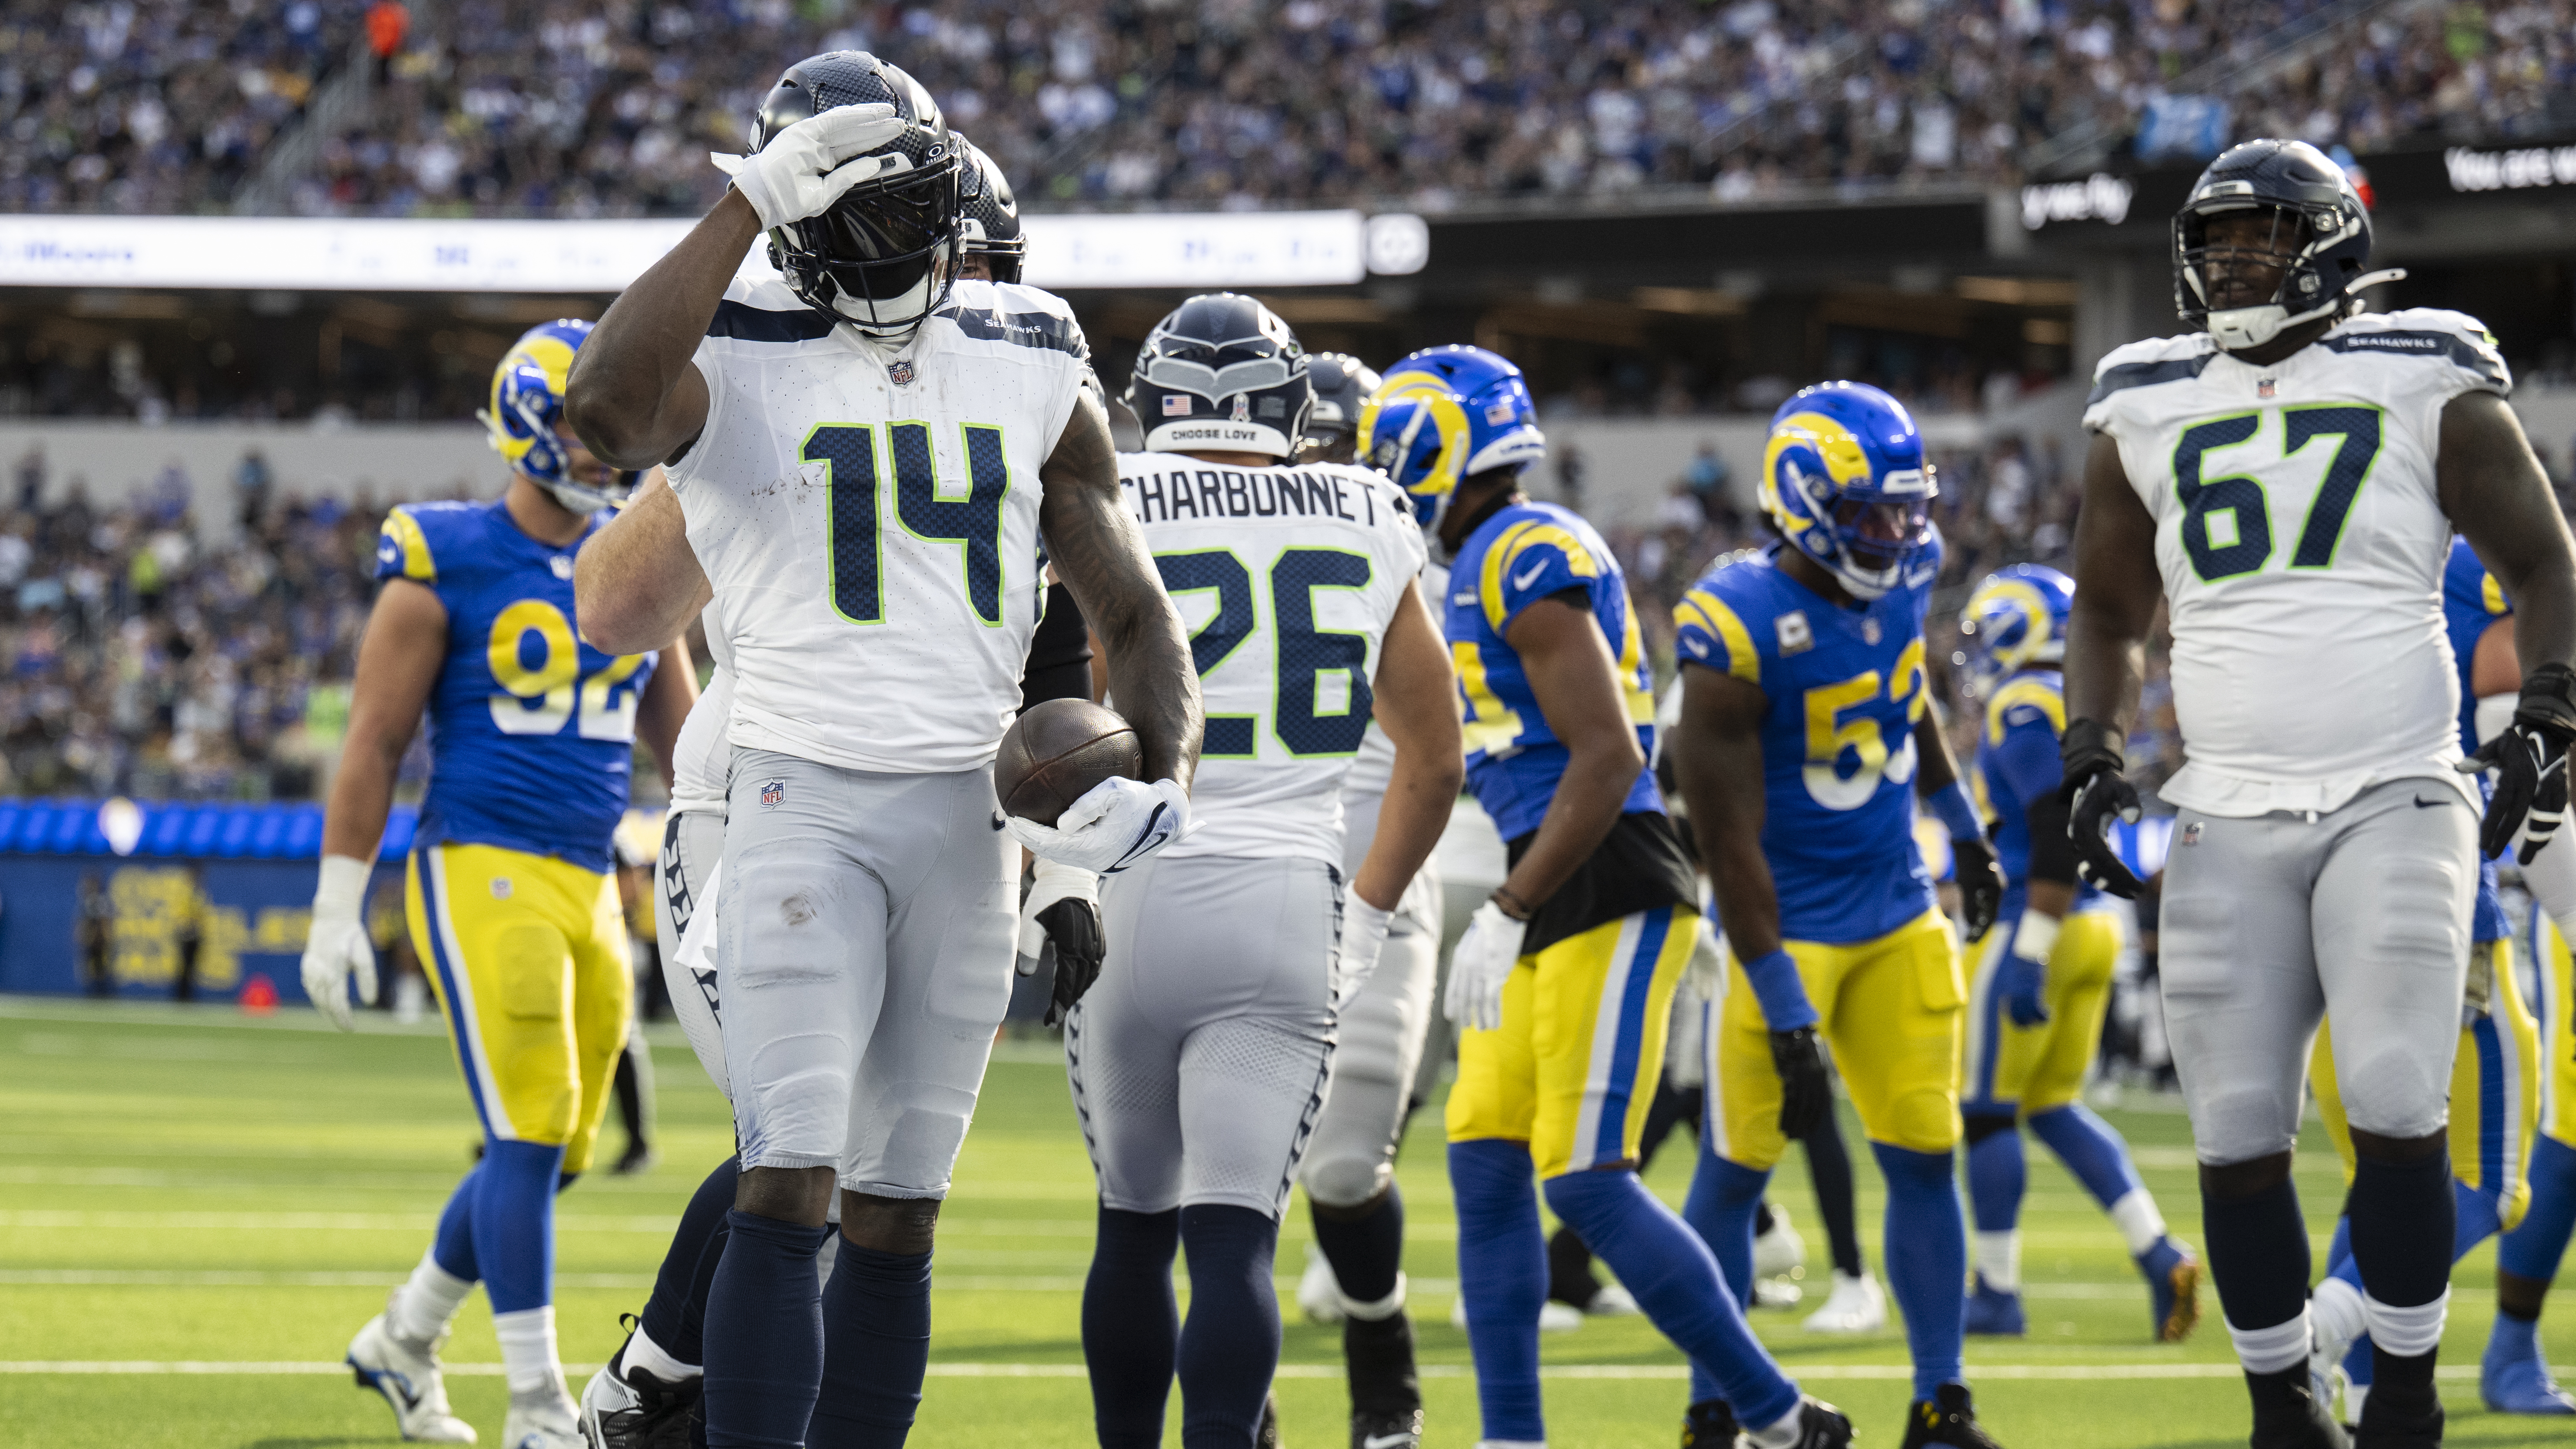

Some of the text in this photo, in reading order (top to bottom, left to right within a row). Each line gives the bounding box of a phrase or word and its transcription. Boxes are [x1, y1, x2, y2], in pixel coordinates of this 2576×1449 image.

[985, 319, 1041, 334] SEAHAWKS
[2347, 337, 2437, 348] SEAHAWKS
[893, 370, 912, 382] NFL
[1172, 429, 1256, 440] CHOOSE LOVE
[2171, 402, 2384, 585] 67
[798, 420, 1011, 627] 14
[1151, 546, 1374, 759] 26
[763, 791, 781, 803] NFL
